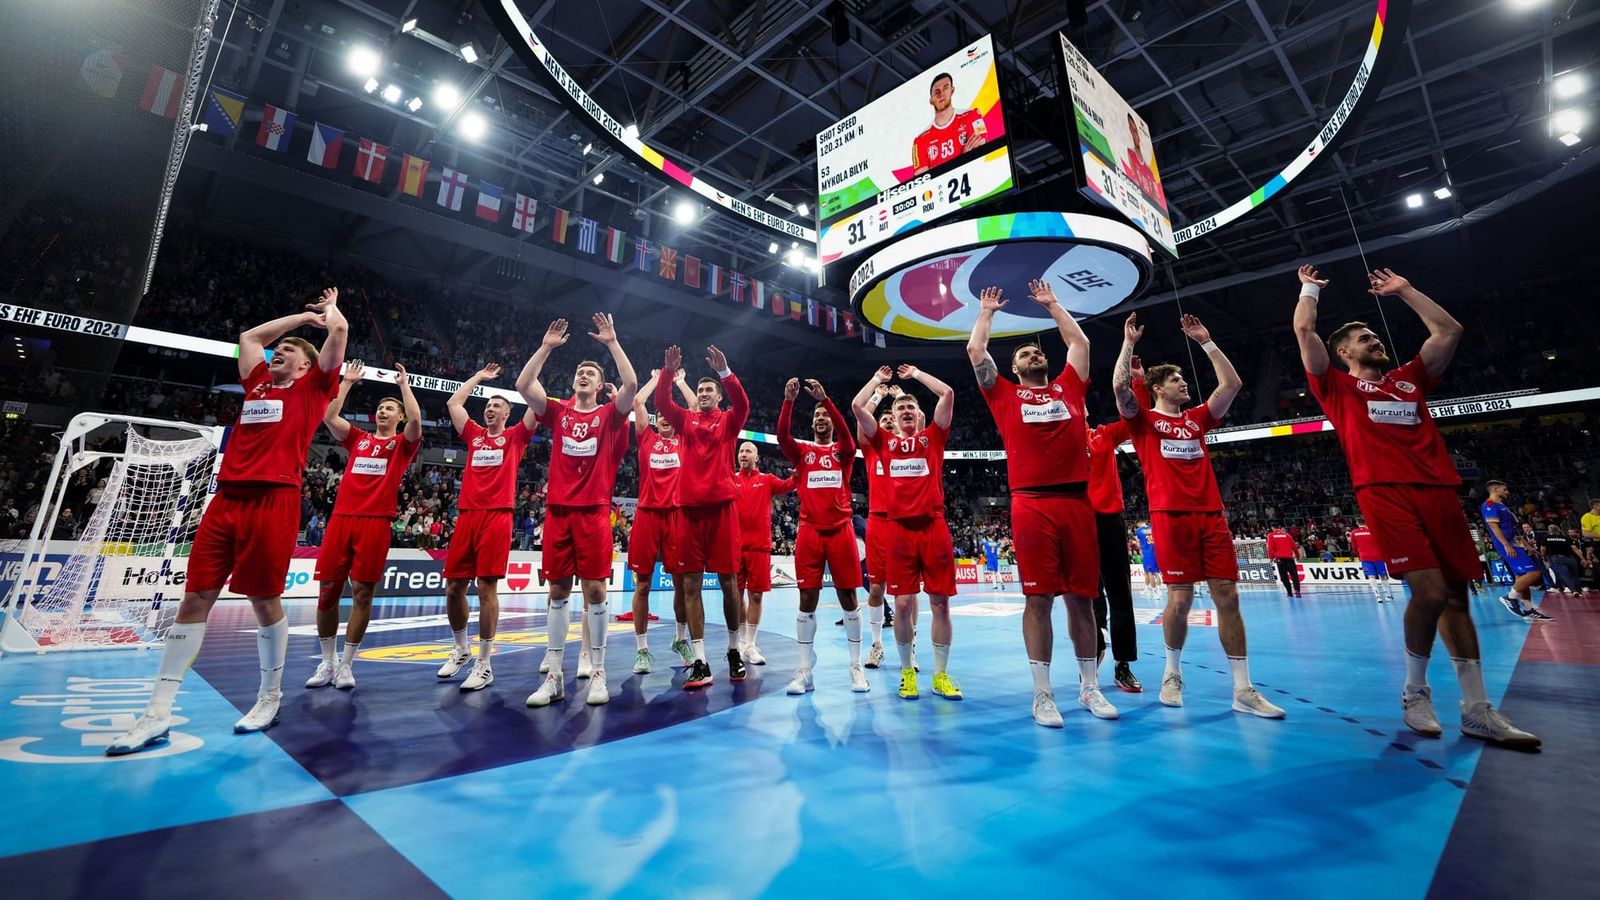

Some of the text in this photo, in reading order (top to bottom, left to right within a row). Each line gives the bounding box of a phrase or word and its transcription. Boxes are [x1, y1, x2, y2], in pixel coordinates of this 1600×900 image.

[1335, 104, 1347, 126] EHF
[1344, 84, 1360, 112] EURO
[1356, 61, 1369, 92] 2024
[567, 79, 582, 101] EHF
[582, 94, 602, 120] EURO
[602, 114, 622, 139] 2024
[819, 115, 857, 144] SHOT SPEED
[820, 137, 843, 157] 120.31
[941, 139, 954, 159] 53
[820, 166, 830, 179] 53
[821, 159, 869, 192] MYKOLA BILYK
[877, 173, 932, 204] Hisense
[947, 172, 972, 204] 24
[894, 198, 916, 214] 30:00
[922, 202, 935, 214] ROU
[753, 209, 766, 222] EHF
[767, 215, 785, 230] EURO
[786, 222, 804, 237] 2024
[847, 218, 867, 245] 31
[1174, 217, 1217, 243] URO 2024
[858, 259, 874, 287] 2024
[1065, 269, 1114, 288] EHF
[13, 308, 42, 324] EHF
[43, 312, 81, 331] EURO
[83, 320, 120, 338] 2024
[423, 377, 440, 389] EHF
[1371, 407, 1417, 417] Kurzurlau
[1439, 405, 1456, 416] EHF
[1457, 402, 1483, 414] EURO
[1484, 399, 1512, 411] 2024
[571, 422, 589, 439] 53
[1205, 434, 1218, 443] 024
[122, 567, 186, 586] Hote
[955, 567, 977, 580] AUSS
[1239, 568, 1270, 580] net
